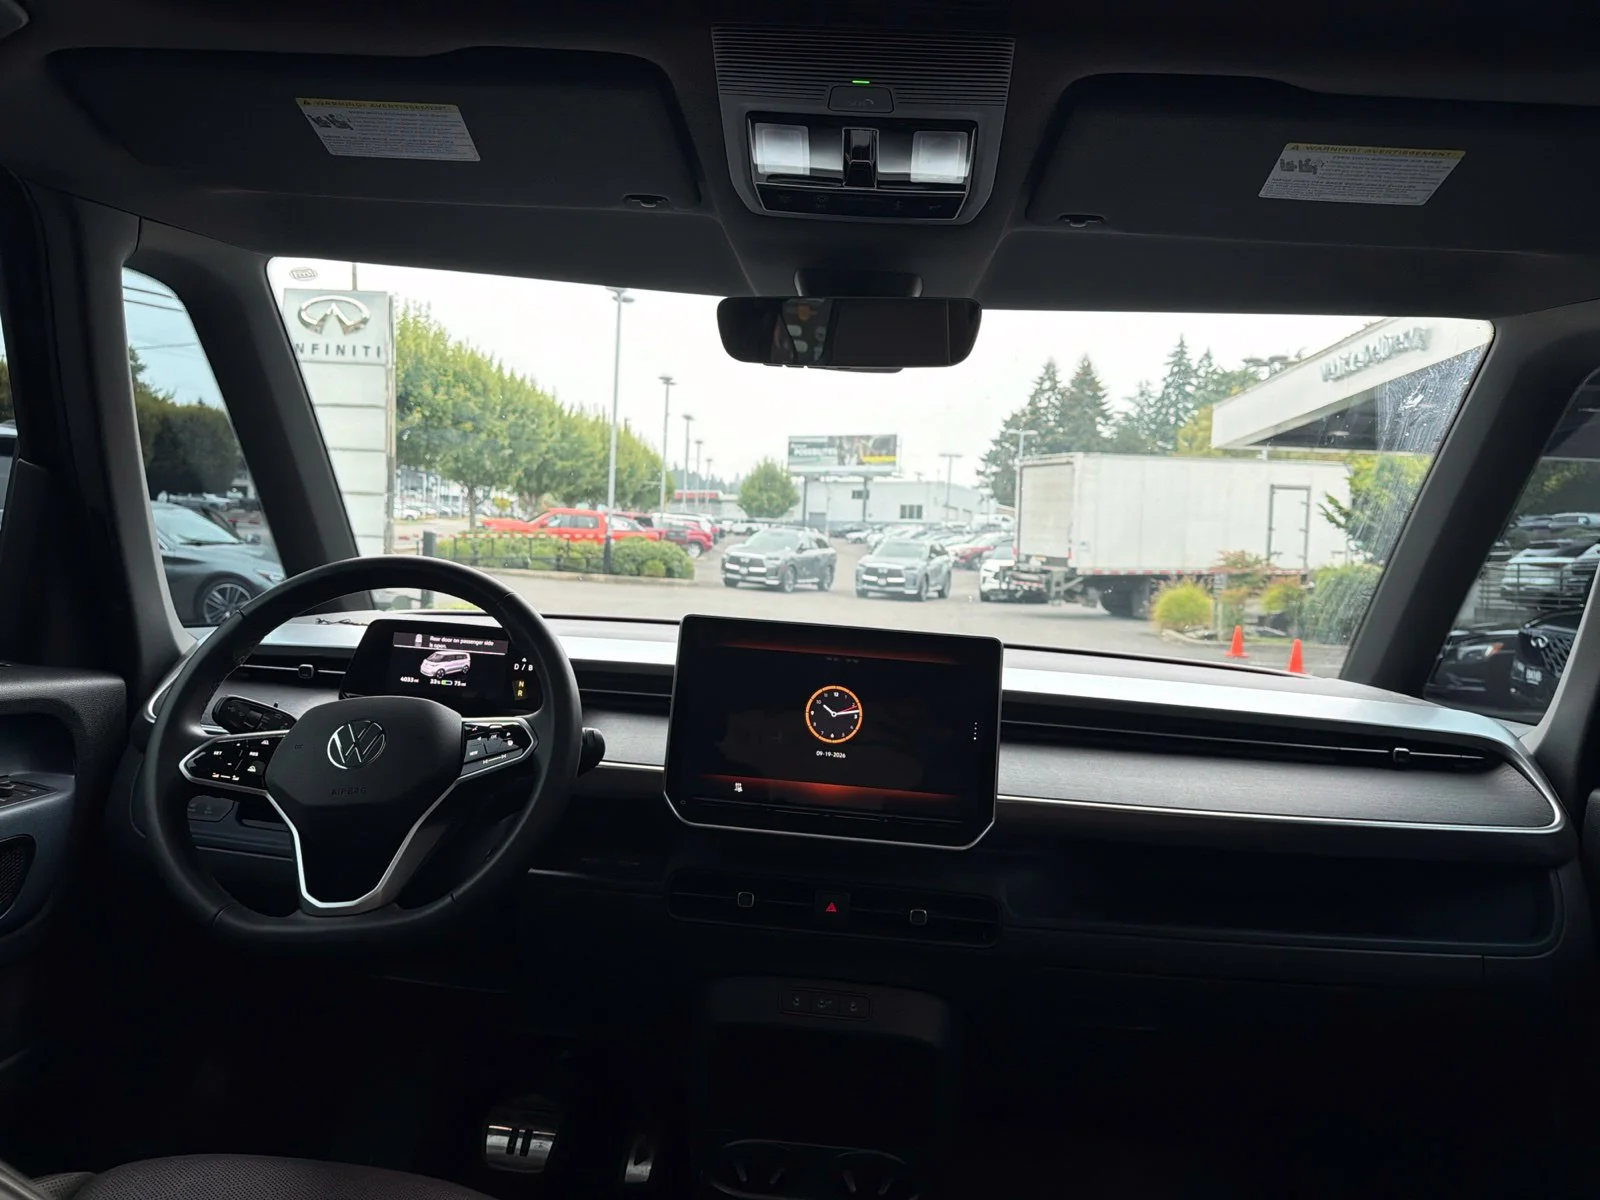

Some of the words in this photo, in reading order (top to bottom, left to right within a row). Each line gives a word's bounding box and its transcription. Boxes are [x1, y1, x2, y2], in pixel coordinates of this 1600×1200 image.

[295, 343, 382, 358] NFINITI
[460, 638, 484, 647] passenger
[815, 750, 847, 759] 09-19-2026
[331, 786, 368, 796] AIRBAG
